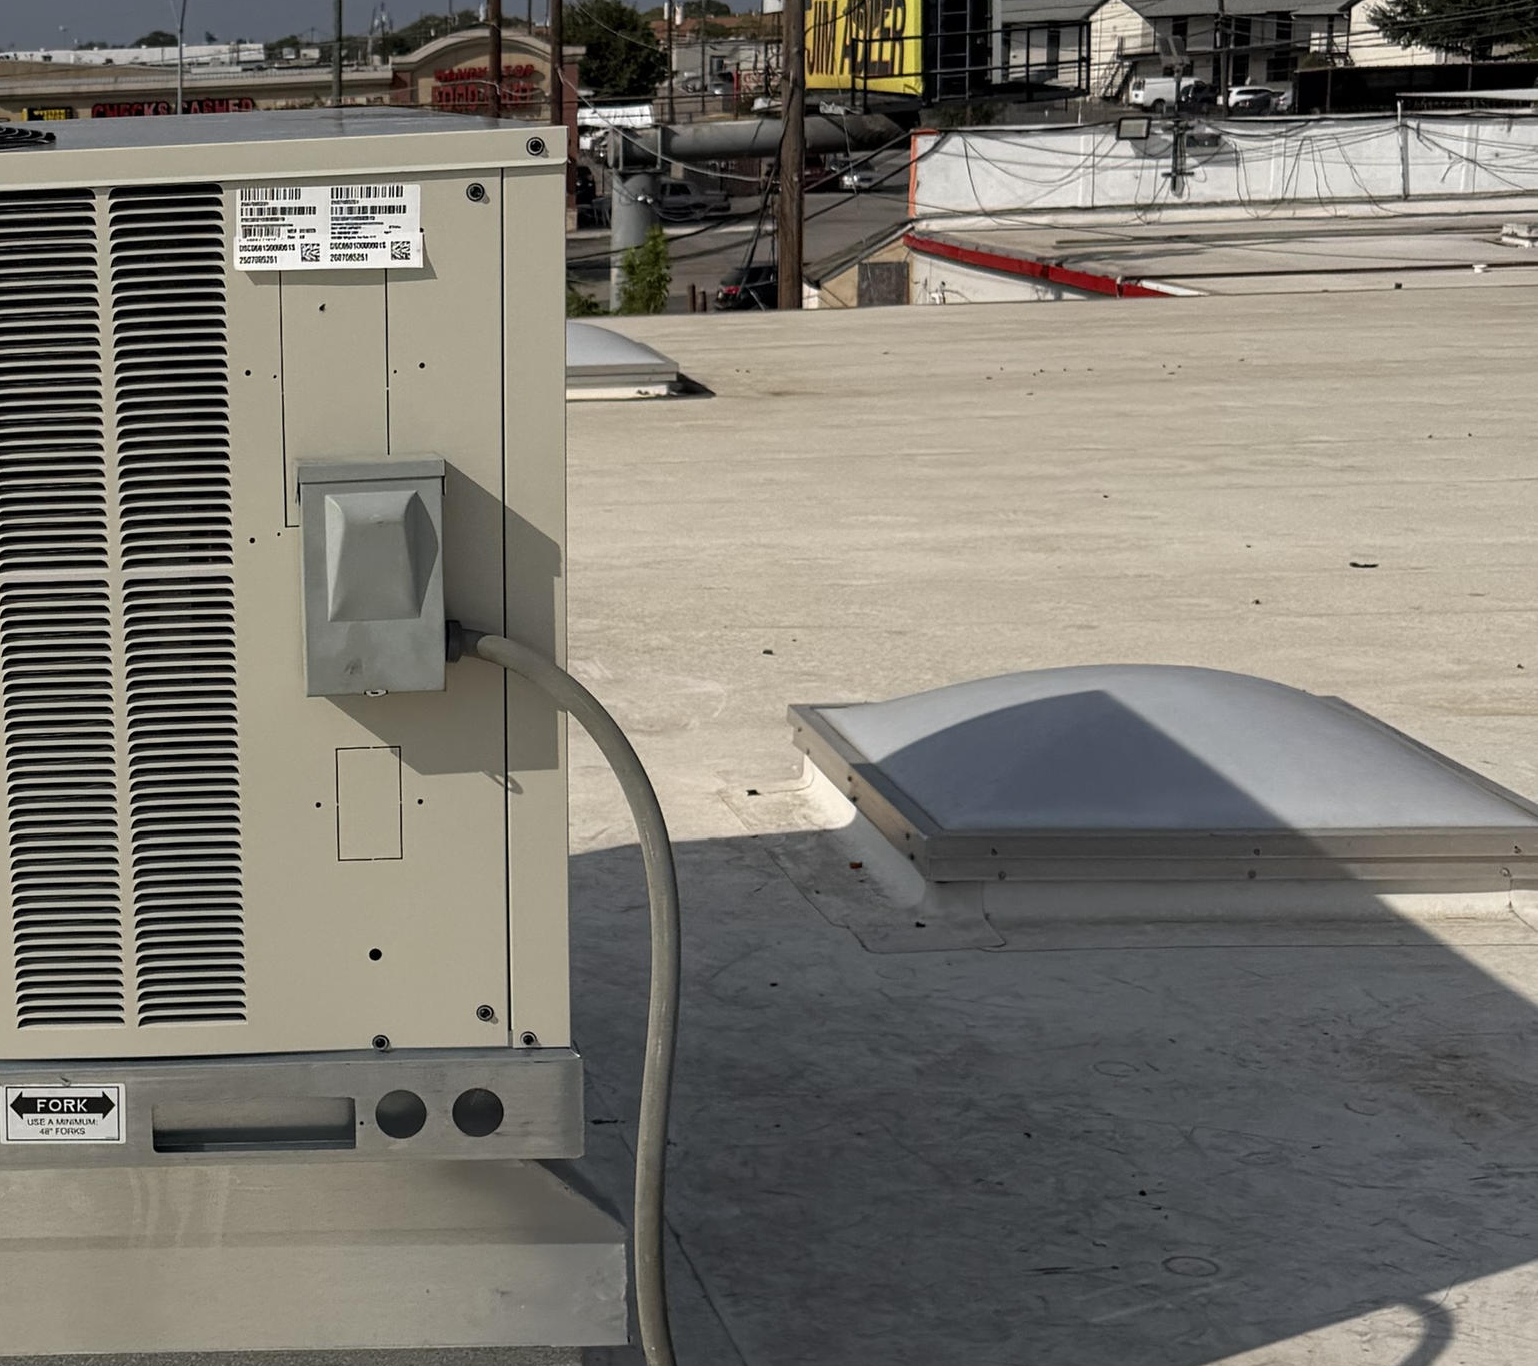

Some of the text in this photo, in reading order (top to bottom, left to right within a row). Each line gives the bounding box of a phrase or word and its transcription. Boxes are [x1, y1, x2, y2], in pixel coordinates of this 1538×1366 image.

[804, 0, 837, 76] JIM
[92, 98, 253, 119] CHECKS CASHED
[36, 1099, 88, 1113] FORK
